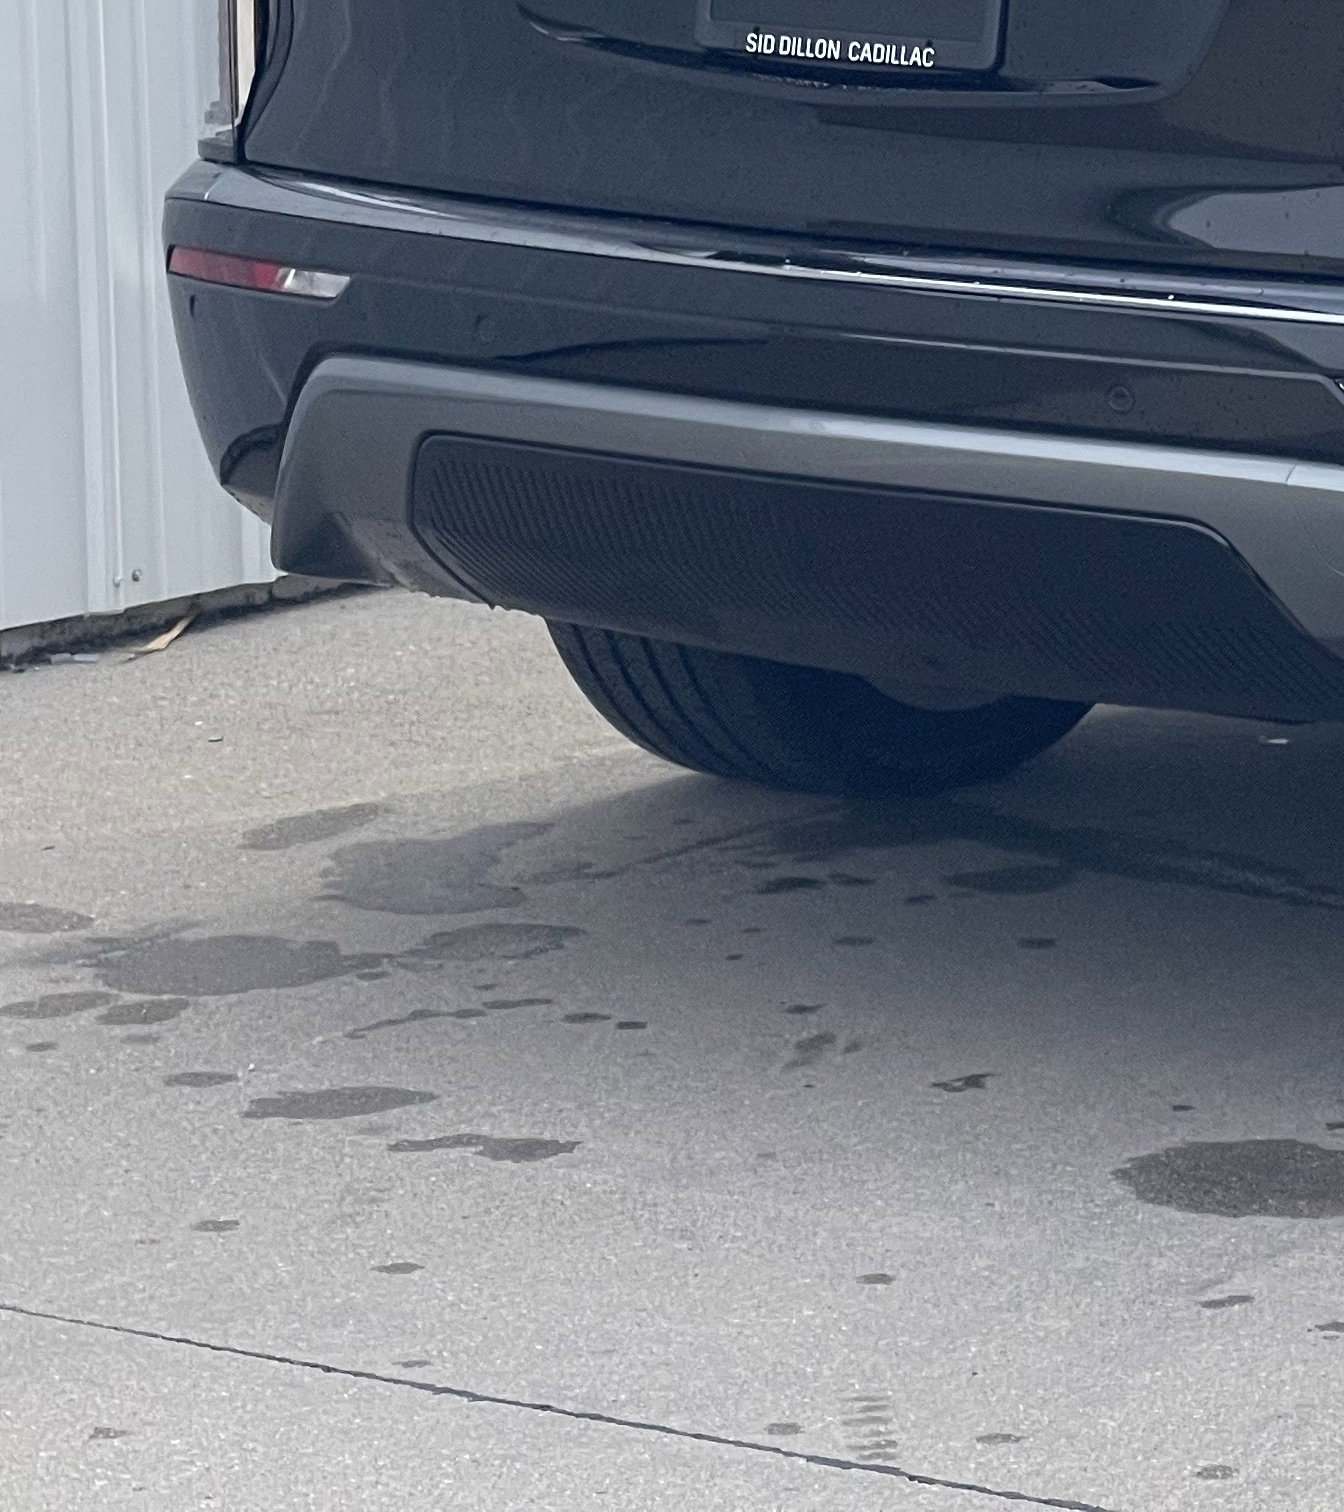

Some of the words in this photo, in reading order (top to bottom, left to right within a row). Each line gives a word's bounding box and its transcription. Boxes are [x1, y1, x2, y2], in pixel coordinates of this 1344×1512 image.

[745, 32, 776, 55] SID
[778, 36, 841, 61] DILLON
[848, 41, 936, 68] CADILLAC
